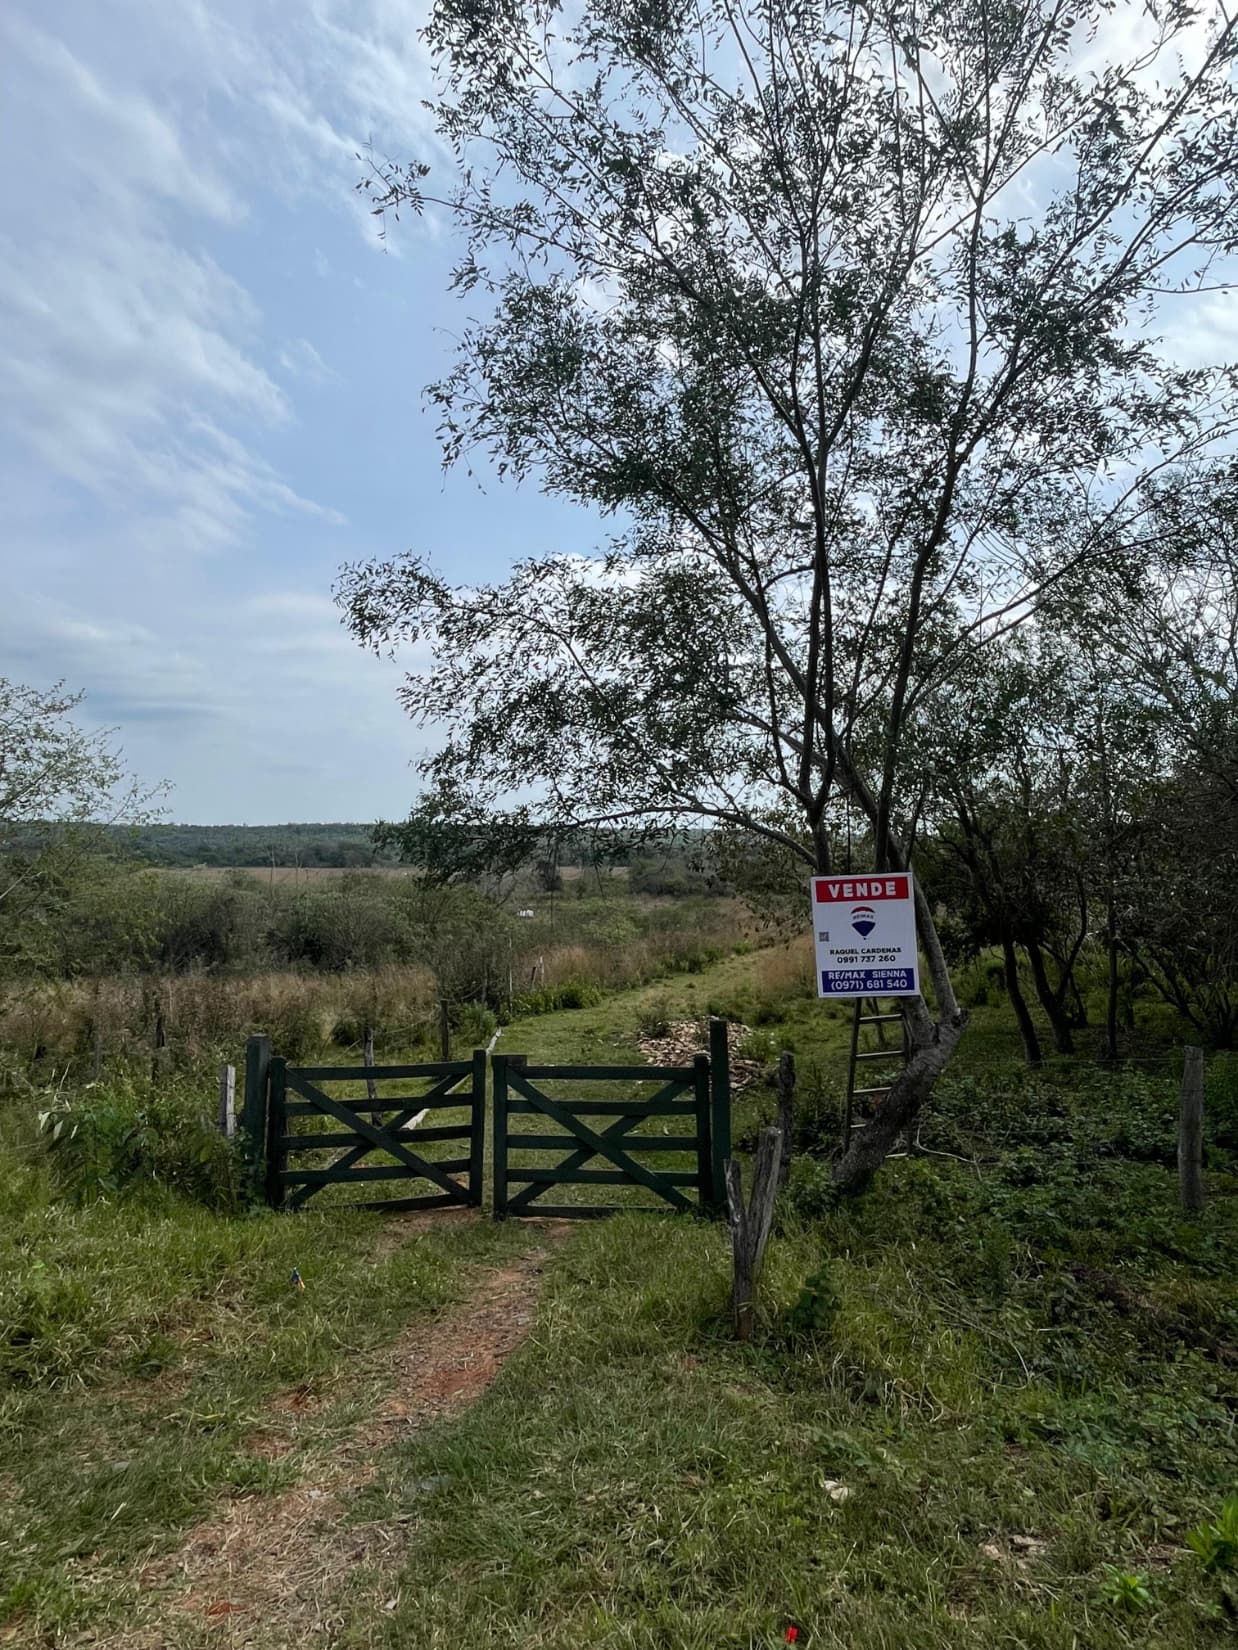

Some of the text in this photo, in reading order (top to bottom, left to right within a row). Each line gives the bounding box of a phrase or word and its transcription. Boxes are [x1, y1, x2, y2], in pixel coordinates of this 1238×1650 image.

[828, 881, 896, 898] VENDE
[861, 955, 875, 963] 737
[828, 970, 907, 980] RE/MAX SIENNA
[831, 979, 908, 991] (0971) 681 540
